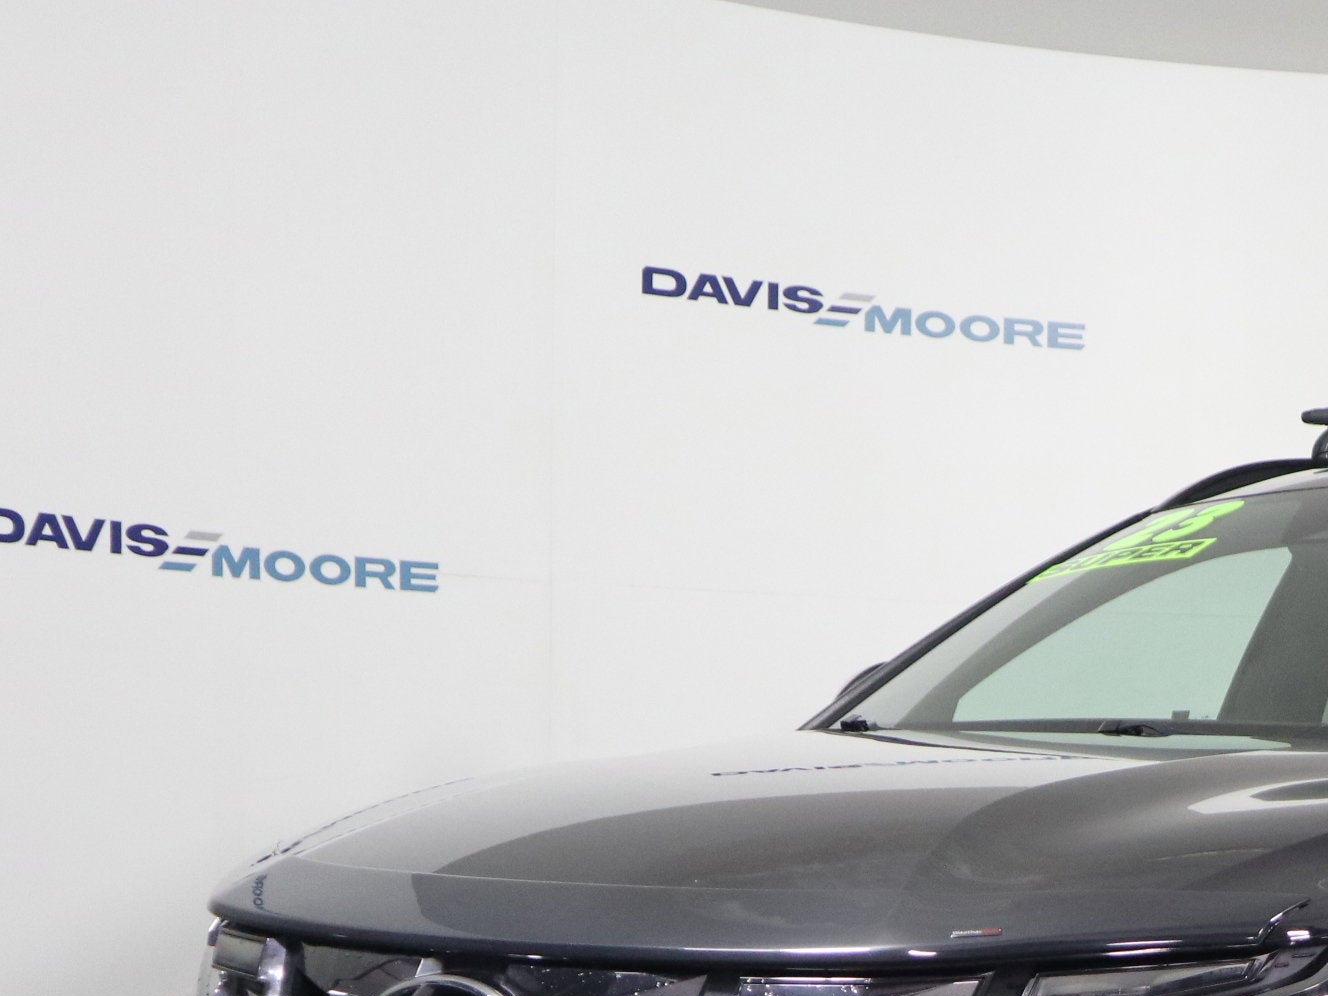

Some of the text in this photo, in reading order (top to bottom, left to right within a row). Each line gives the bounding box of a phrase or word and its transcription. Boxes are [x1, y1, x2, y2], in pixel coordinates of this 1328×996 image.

[642, 265, 1086, 351] DAVIS MOORE
[211, 544, 440, 593] MOORE
